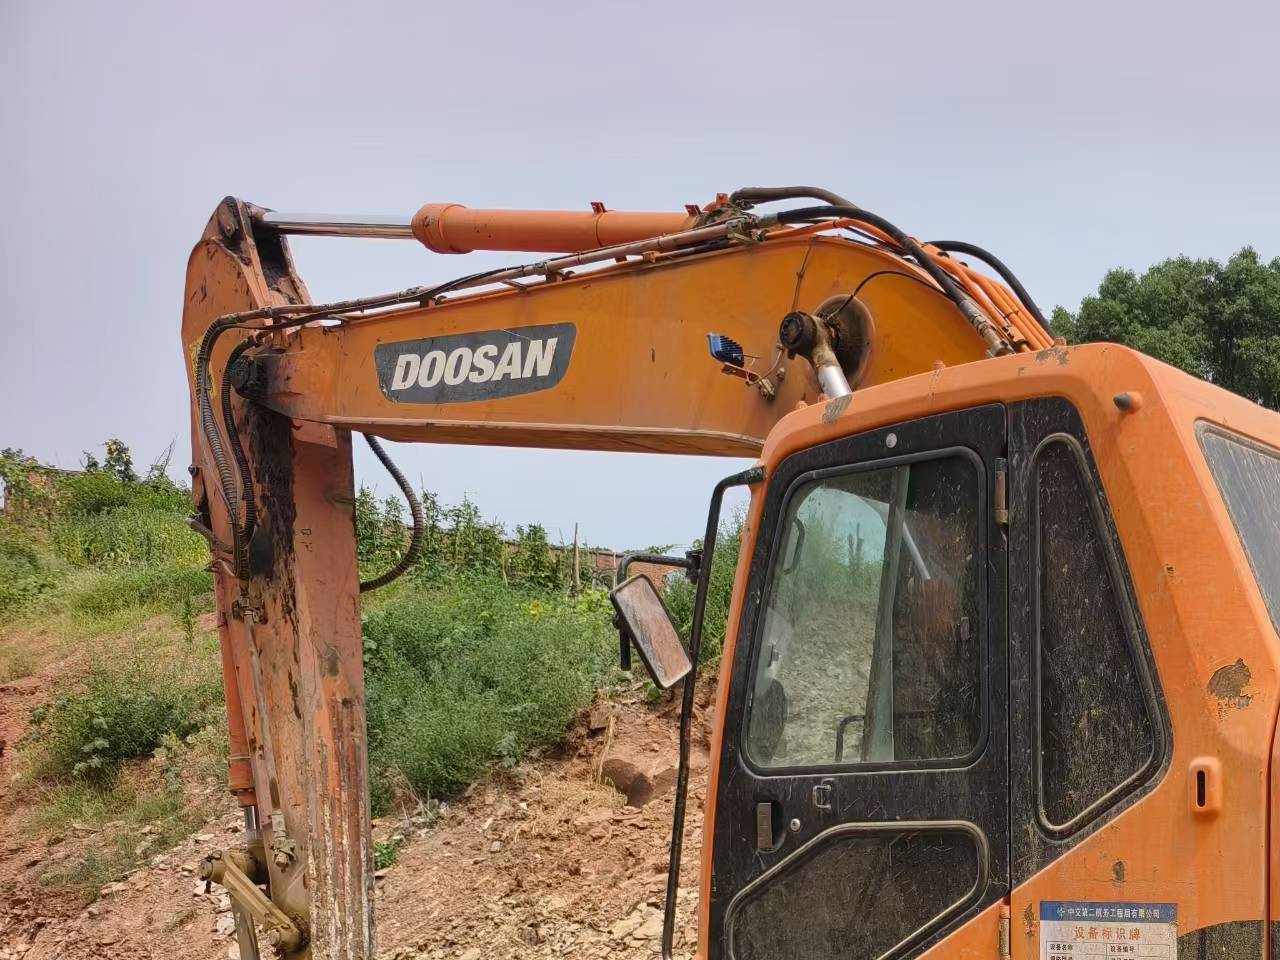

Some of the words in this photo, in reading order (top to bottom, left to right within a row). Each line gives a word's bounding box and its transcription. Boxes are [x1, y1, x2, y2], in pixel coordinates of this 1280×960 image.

[391, 338, 558, 391] DOOSAN
[1074, 926, 1141, 941] 设备标识牌
[1049, 943, 1073, 951] 设备名称
[1110, 945, 1135, 954] 设备编号
